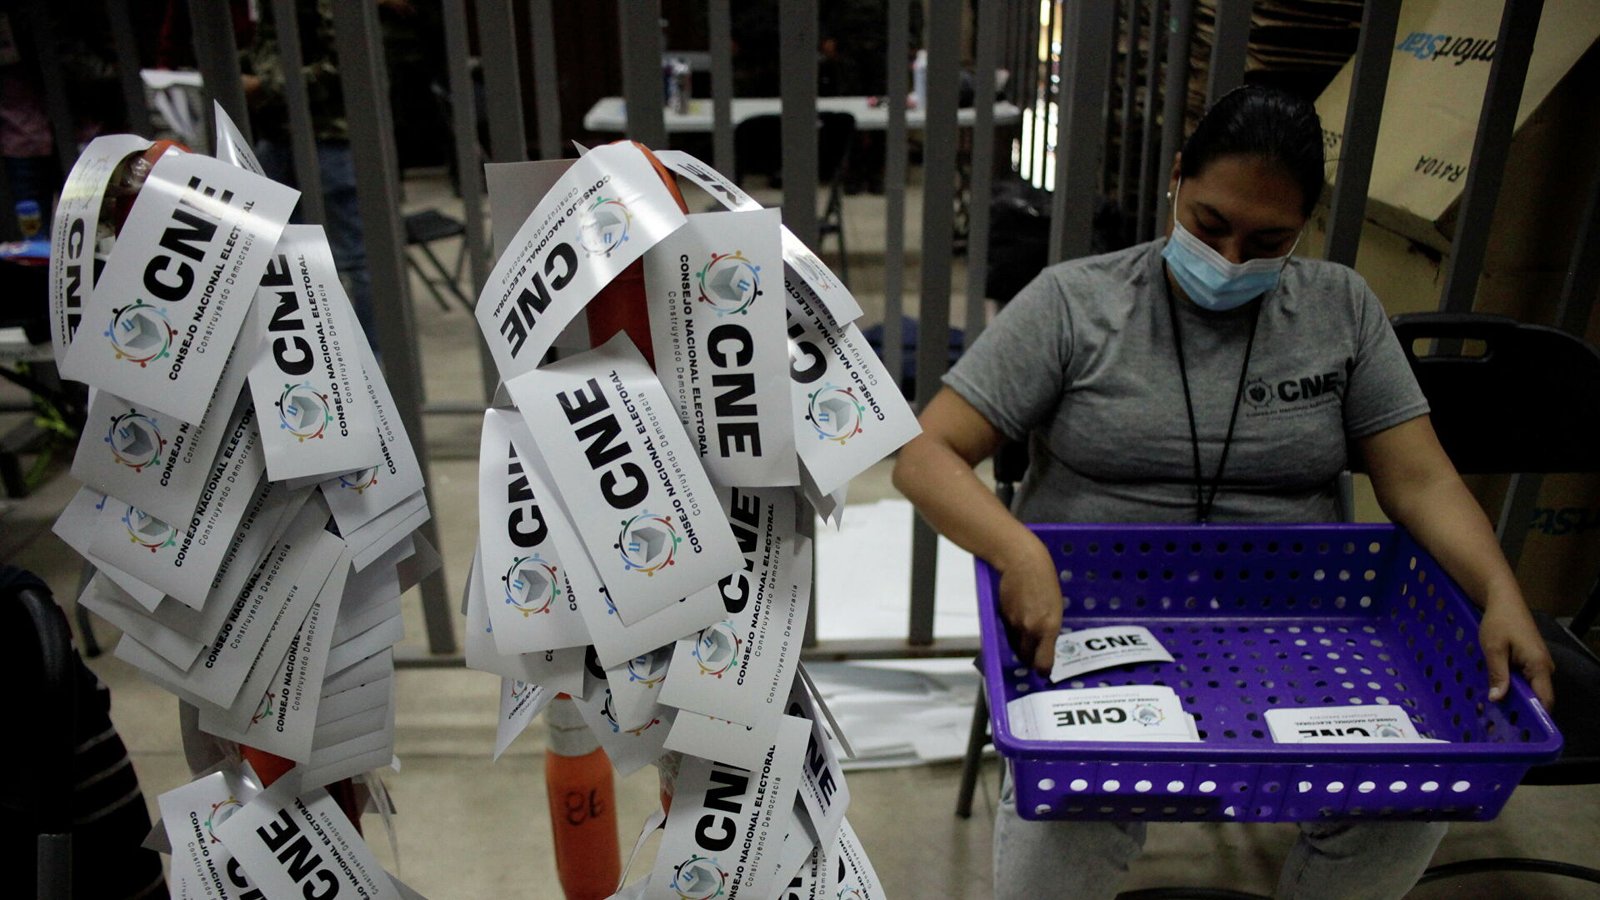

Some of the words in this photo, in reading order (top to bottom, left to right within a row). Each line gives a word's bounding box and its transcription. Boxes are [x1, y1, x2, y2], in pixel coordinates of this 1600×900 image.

[1415, 155, 1466, 182] R410A
[143, 176, 234, 302] CNE
[525, 216, 567, 265] NACIONAL
[533, 186, 579, 240] Construyendo
[196, 286, 230, 355] Construyendo
[226, 232, 257, 286] Democracia
[297, 253, 321, 319] ELECTORAL
[492, 264, 528, 318] ELECTORAL
[500, 240, 534, 285] Democracia
[680, 254, 693, 316] CONSEJO
[168, 322, 199, 381] CONSEJO
[194, 262, 227, 323] NACIONAL
[317, 283, 338, 337] Democracia
[500, 242, 579, 360] CNE
[315, 321, 336, 379] NACIONAL
[333, 340, 354, 404] Construyendo
[668, 291, 682, 363] Construyendo
[676, 366, 690, 425] Democracia
[684, 318, 700, 384] NACIONAL
[812, 316, 853, 371] NACIONAL
[836, 327, 878, 387] Construyendo
[330, 381, 349, 438] CONSEJO
[366, 384, 395, 442] Construyendo
[608, 369, 647, 435] ELECTORAL
[706, 324, 763, 458] CNE
[850, 370, 886, 422] CONSEJO
[1277, 371, 1340, 402] CNE
[555, 377, 650, 510] CNE
[637, 391, 668, 449] Democracia
[692, 387, 710, 459] ELECTORAL
[159, 434, 187, 487] CONSEJO
[198, 487, 232, 546] Construyendo
[227, 431, 259, 484] Democracia
[642, 435, 677, 498] NACIONAL
[665, 449, 702, 517] Construyendo
[174, 517, 202, 568] CONSEJO
[195, 461, 228, 518] NACIONAL
[671, 498, 703, 554] CONSEJO
[204, 622, 234, 669] CONSEJO
[231, 570, 262, 623] NACIONAL
[230, 595, 265, 650] Construyendo
[260, 542, 292, 593] Democracia
[736, 630, 756, 686] CONSEJO
[750, 570, 769, 632] NACIONAL
[762, 503, 775, 568] ELECTORAL
[754, 598, 774, 658] Construyendo
[768, 535, 783, 596] Democracia
[291, 659, 309, 712] Construyendo
[303, 602, 321, 653] Democracia
[766, 640, 789, 704] Construyendo
[784, 583, 798, 638] Democracia
[1084, 633, 1148, 652] CNE
[276, 687, 292, 733] CONSEJO
[1053, 706, 1128, 728] CNE
[189, 811, 210, 857] CONSEJO
[293, 796, 332, 846] ELECTORAL
[319, 811, 349, 852] Democracia
[739, 813, 760, 864] NACIONAL
[754, 744, 777, 812] ELECTORAL
[745, 831, 767, 888] Construyendo
[762, 776, 782, 828] Democracia
[187, 841, 213, 896] Construyendo
[256, 808, 340, 900] CNE
[328, 845, 360, 888] NACIONAL
[347, 850, 380, 896] Construyendo
